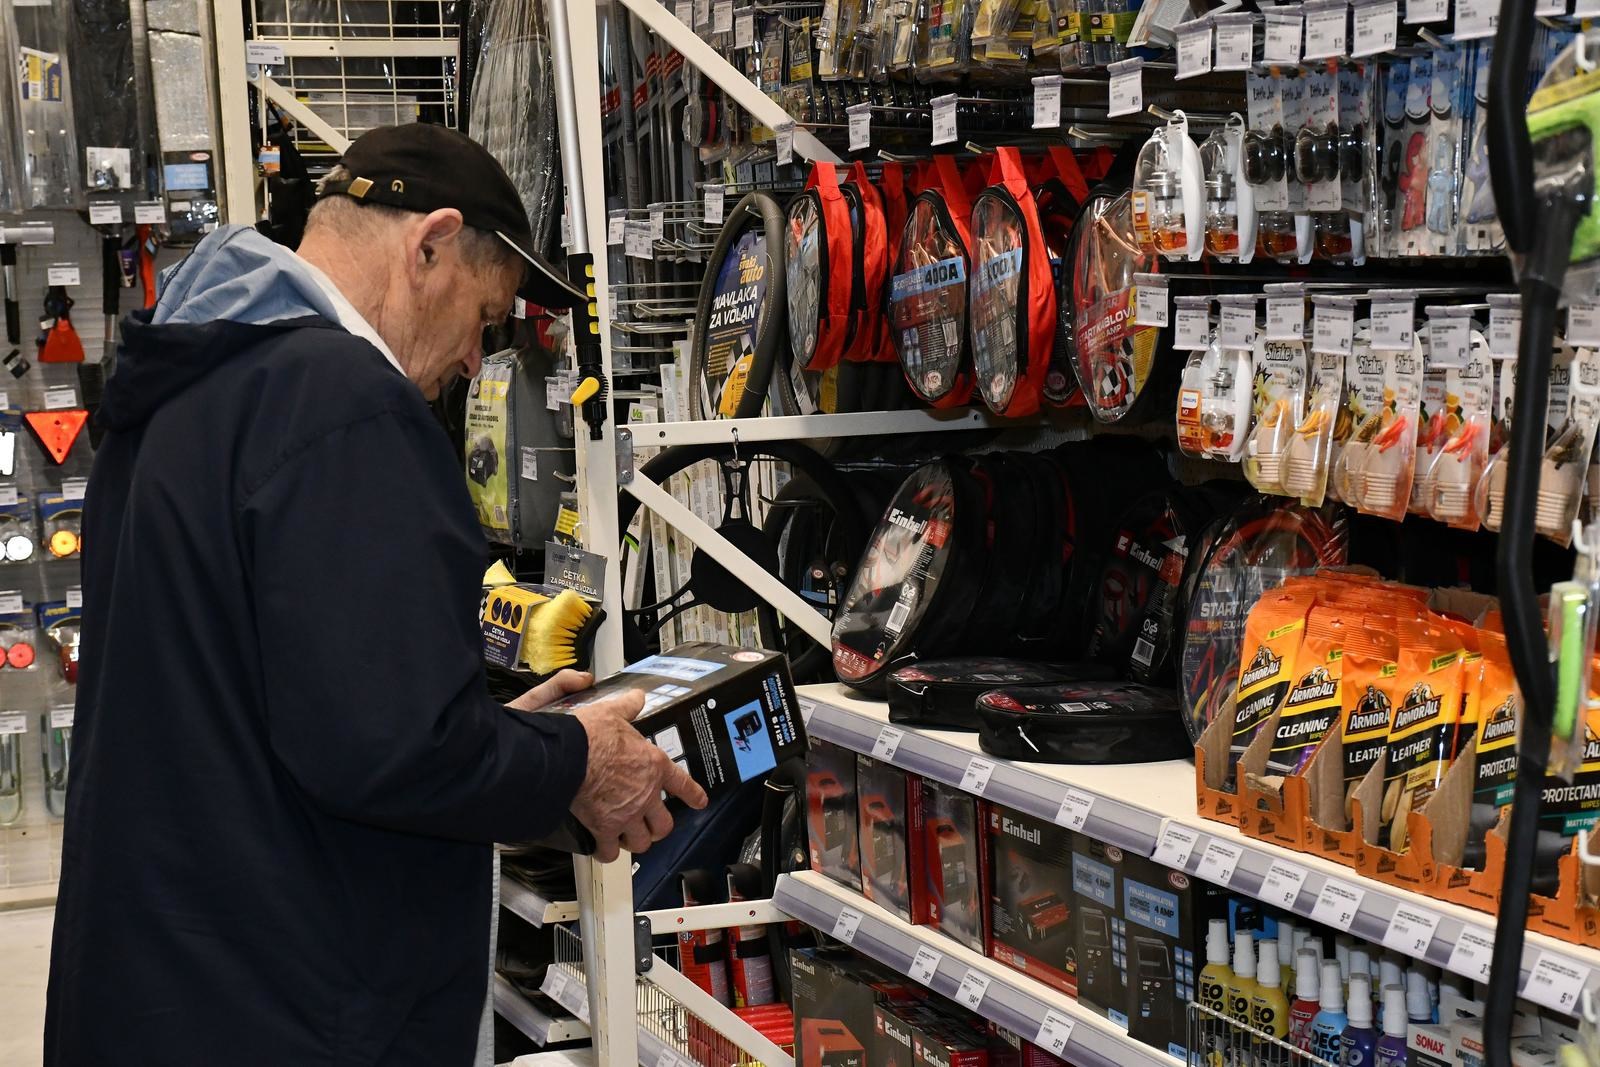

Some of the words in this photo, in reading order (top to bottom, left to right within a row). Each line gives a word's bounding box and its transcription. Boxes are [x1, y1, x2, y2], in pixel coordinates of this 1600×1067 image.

[740, 265, 764, 285] auto
[924, 262, 959, 286] 400A
[713, 285, 758, 311] NAVLAKA
[709, 312, 721, 330] ZA
[724, 303, 756, 326] VOLAN
[887, 507, 928, 535] Einhell
[1129, 541, 1164, 572] Einhell
[550, 576, 558, 585] ZA
[564, 567, 586, 584] ČETKA
[1200, 602, 1239, 617] START
[1241, 661, 1280, 687] ARMORALL
[1290, 682, 1336, 704] ARMORALL
[1236, 692, 1275, 723] CLEANING
[1395, 701, 1439, 728] ARMORALL
[1276, 717, 1330, 739] CLEANING
[1350, 709, 1390, 730] ARMORA
[1485, 717, 1515, 739] ARMOR
[1349, 745, 1387, 764] LEATHE
[1392, 737, 1432, 763] LEATHER
[1480, 757, 1517, 779] PROTECTA
[1002, 816, 1041, 846] Einhell
[1566, 816, 1582, 828] MATT
[1154, 905, 1159, 914] 4
[1159, 906, 1175, 918] AMP
[1154, 916, 1167, 928] 12V
[792, 957, 815, 976] Einhell
[1200, 982, 1223, 1000] EO
[1229, 994, 1249, 1013] EO
[1251, 1005, 1275, 1024] EO
[885, 1021, 911, 1048] Einhell
[1416, 1033, 1444, 1055] SONAX
